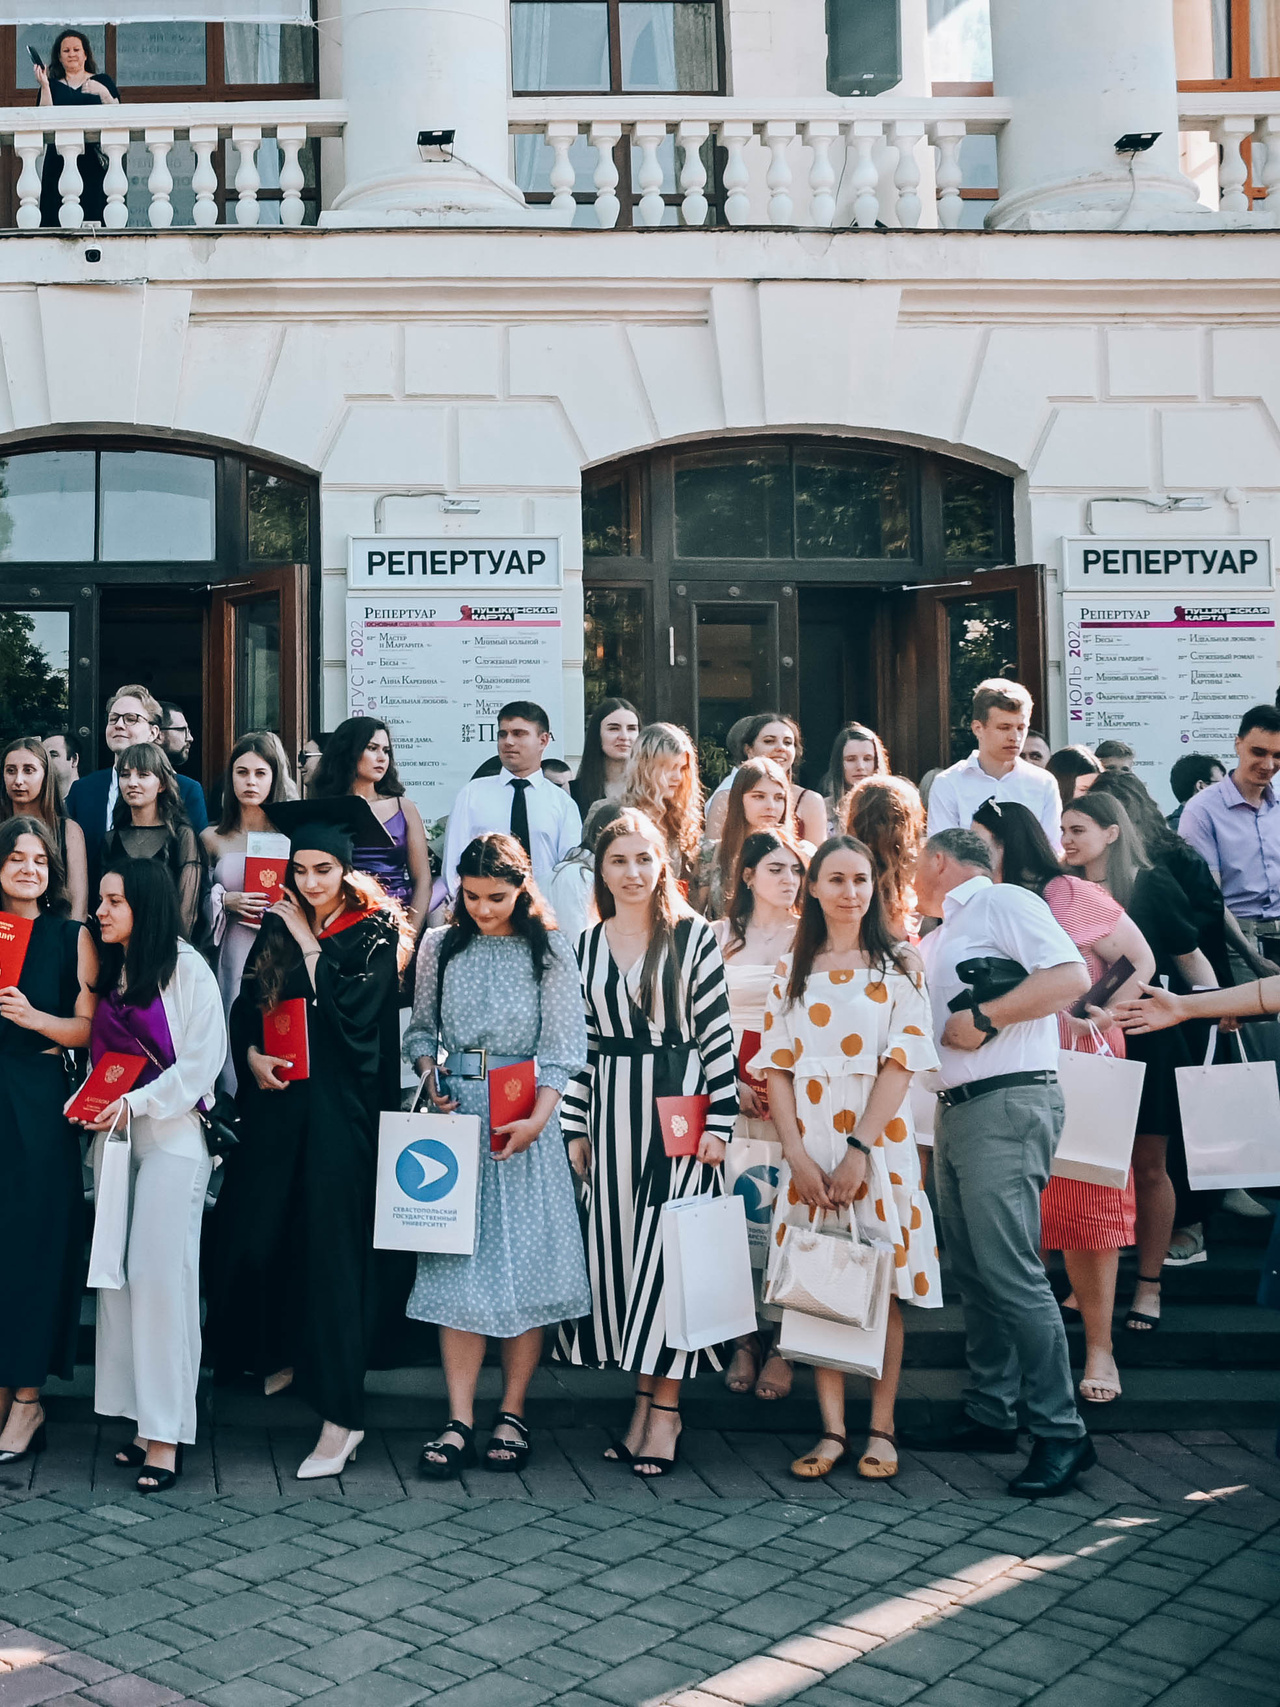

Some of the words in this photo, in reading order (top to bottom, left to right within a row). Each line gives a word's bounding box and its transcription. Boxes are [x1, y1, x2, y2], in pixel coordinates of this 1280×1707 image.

[368, 550, 546, 575] РЕПЕРТУАР
[1083, 550, 1258, 574] РЕПЕРТУАР
[350, 620, 364, 657] 2022
[1067, 622, 1081, 658] 2022
[351, 664, 365, 717] ВГУСТ
[1069, 666, 1083, 721] ИЮЛЬ
[392, 1206, 458, 1215] СЕВАСТОПОЛЬСКИЙ
[392, 1214, 457, 1222] ГОСУДАРСТВЕННЫЙ
[402, 1220, 447, 1228] УНИВЕРСИТЕТ
